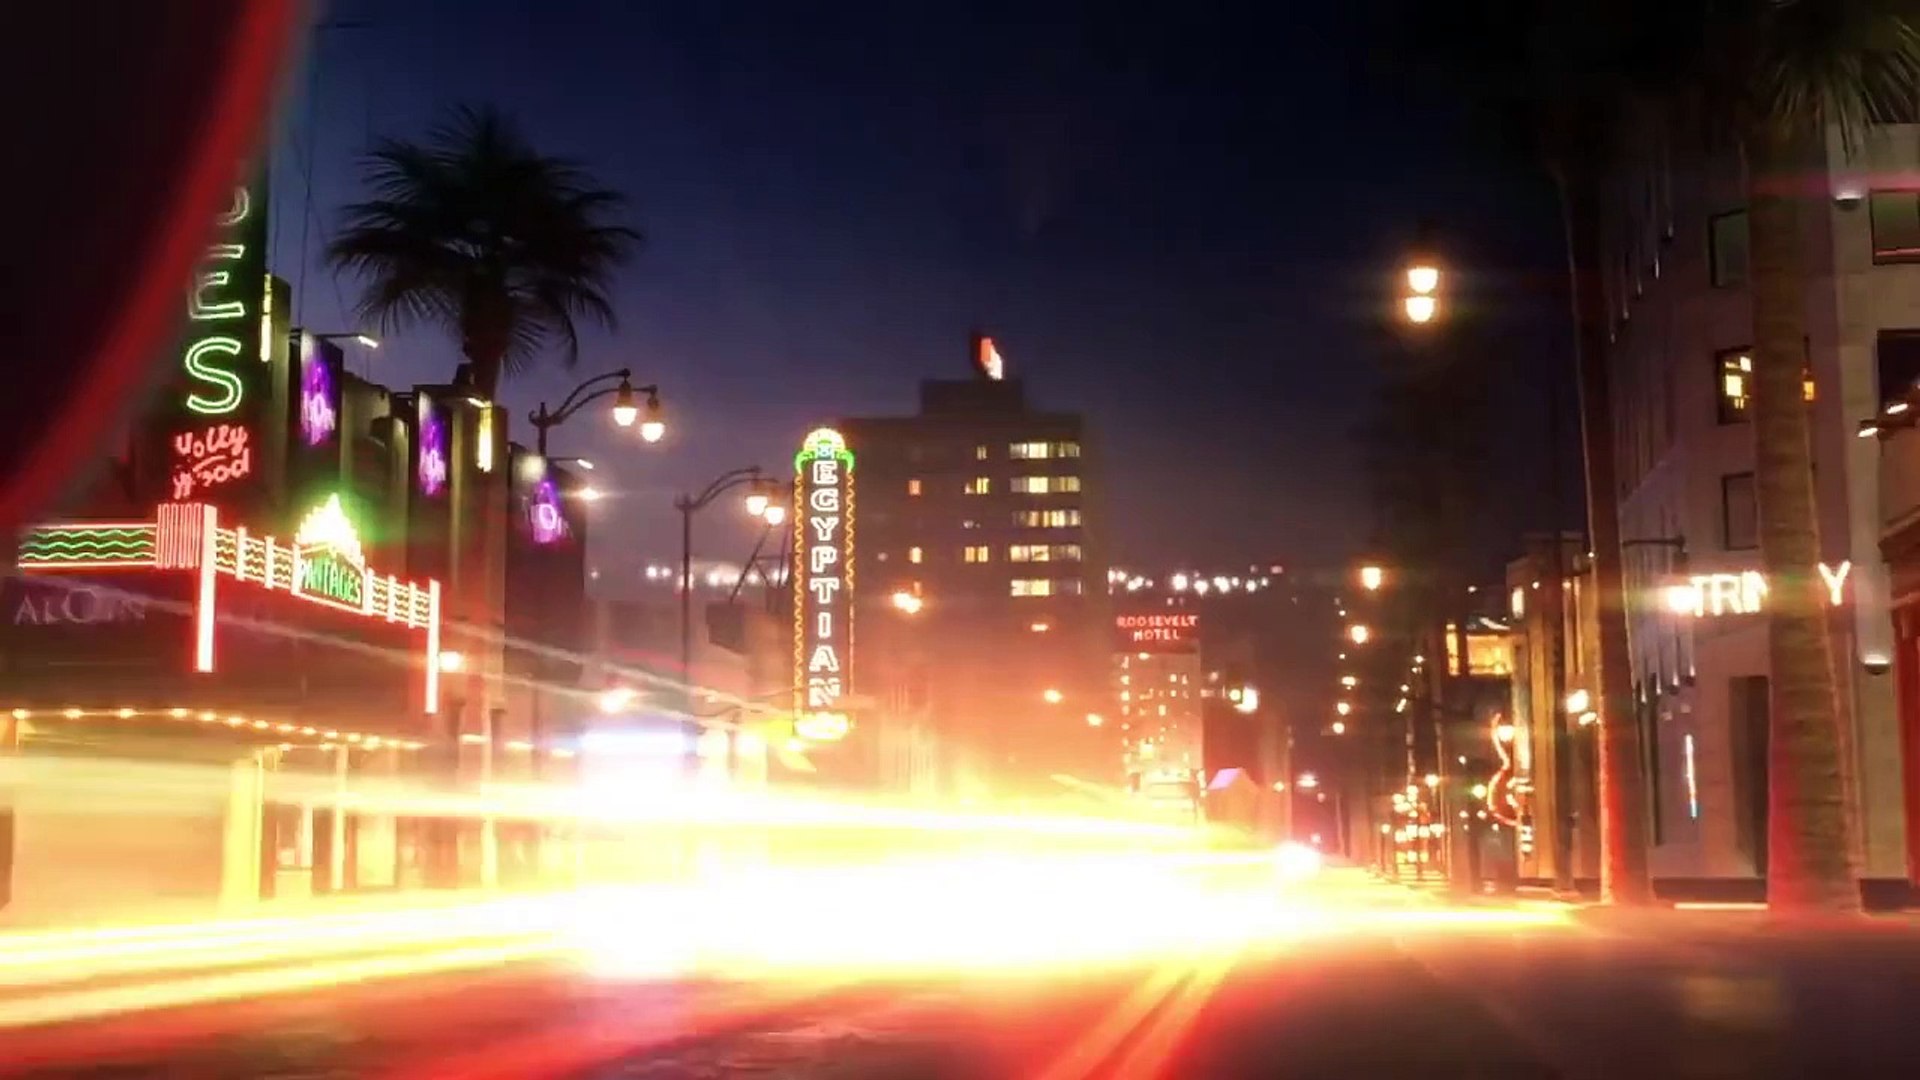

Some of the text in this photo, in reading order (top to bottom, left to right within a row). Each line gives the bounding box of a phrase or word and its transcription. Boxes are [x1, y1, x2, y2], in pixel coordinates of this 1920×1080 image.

[809, 460, 840, 707] EGYPTIAN
[1116, 614, 1199, 628] ROOSEVELT
[1133, 628, 1181, 641] HOTEL
